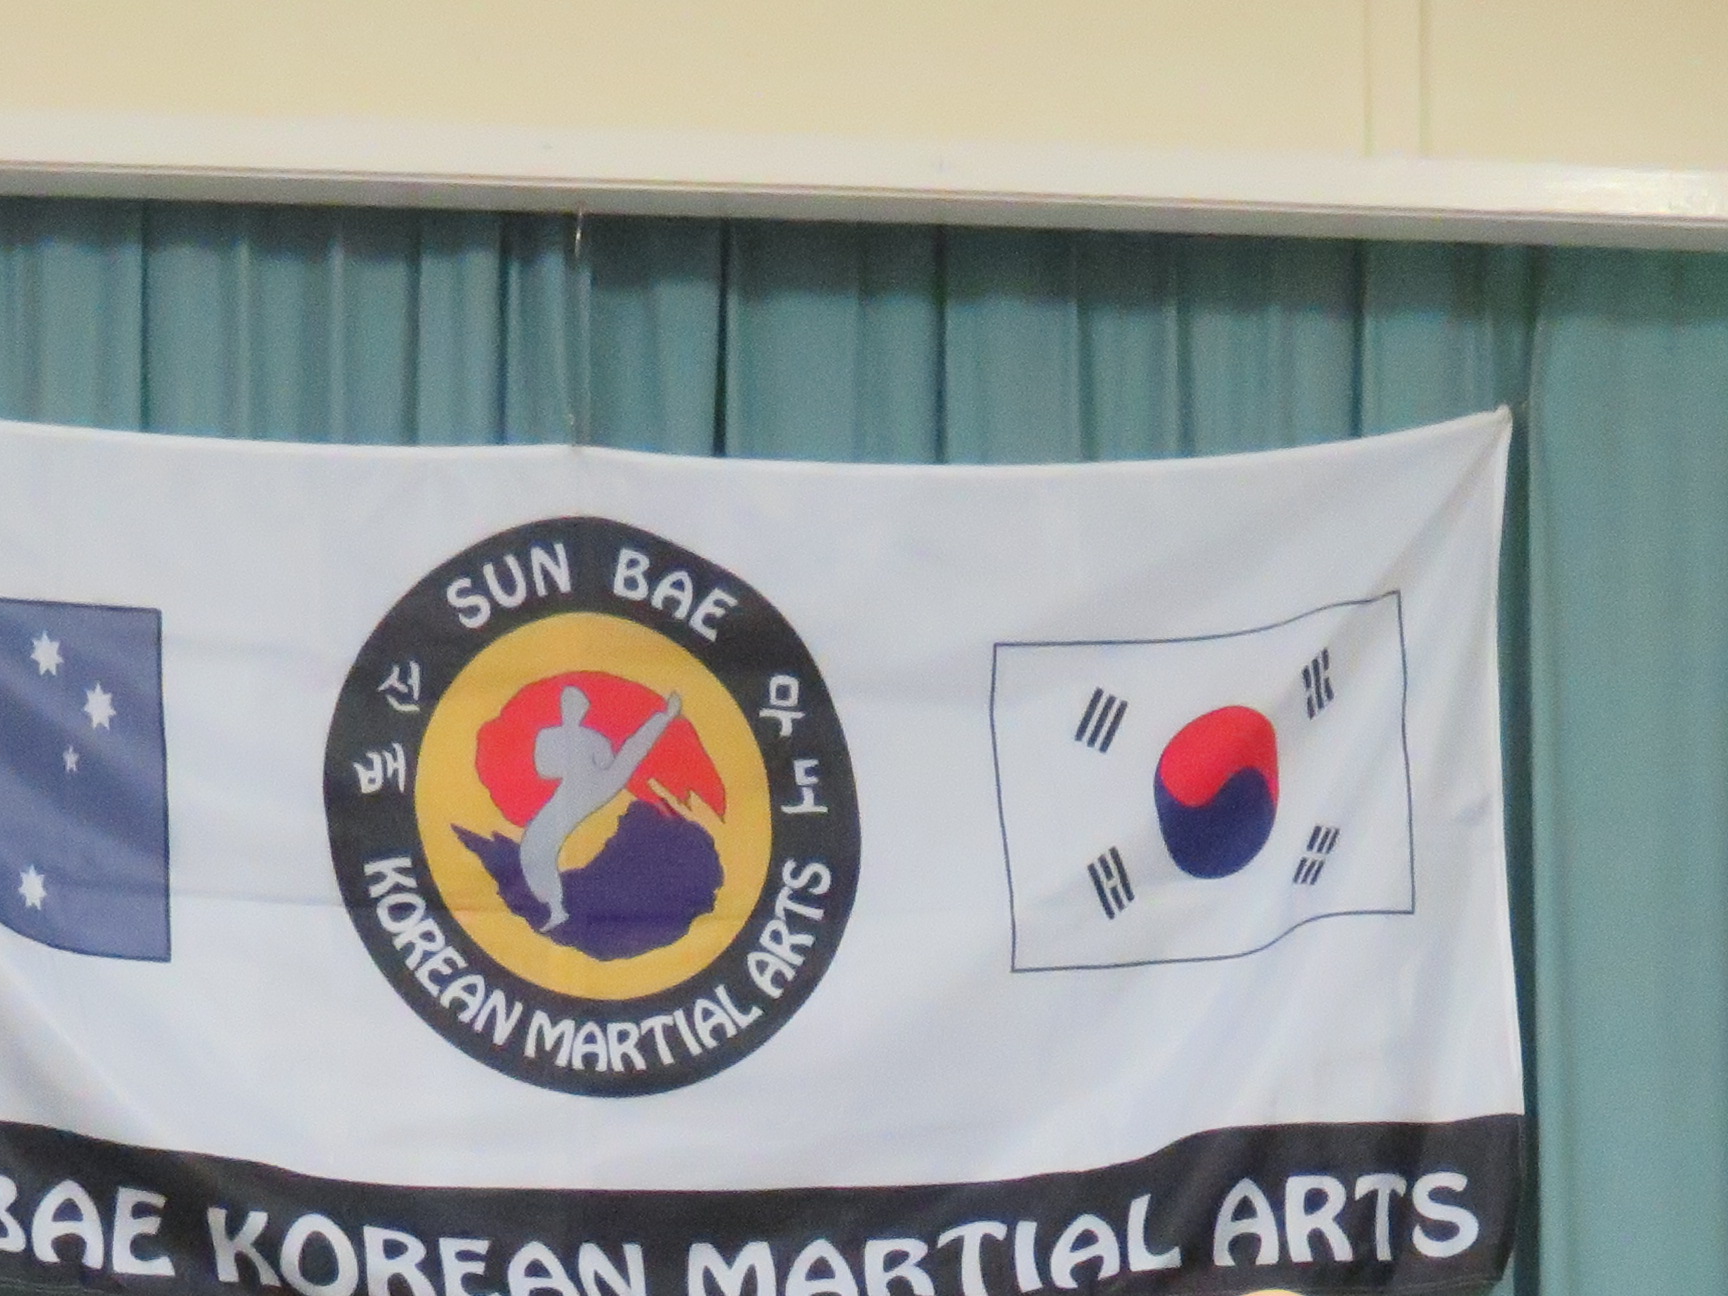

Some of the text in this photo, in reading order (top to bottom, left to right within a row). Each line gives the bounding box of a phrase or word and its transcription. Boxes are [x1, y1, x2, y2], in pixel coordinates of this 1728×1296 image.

[446, 542, 738, 642] SUN BAE
[758, 674, 829, 815] 무도
[363, 856, 832, 1072] KOREAN MARTIAL ARTS
[1212, 1171, 1480, 1268] ARTS
